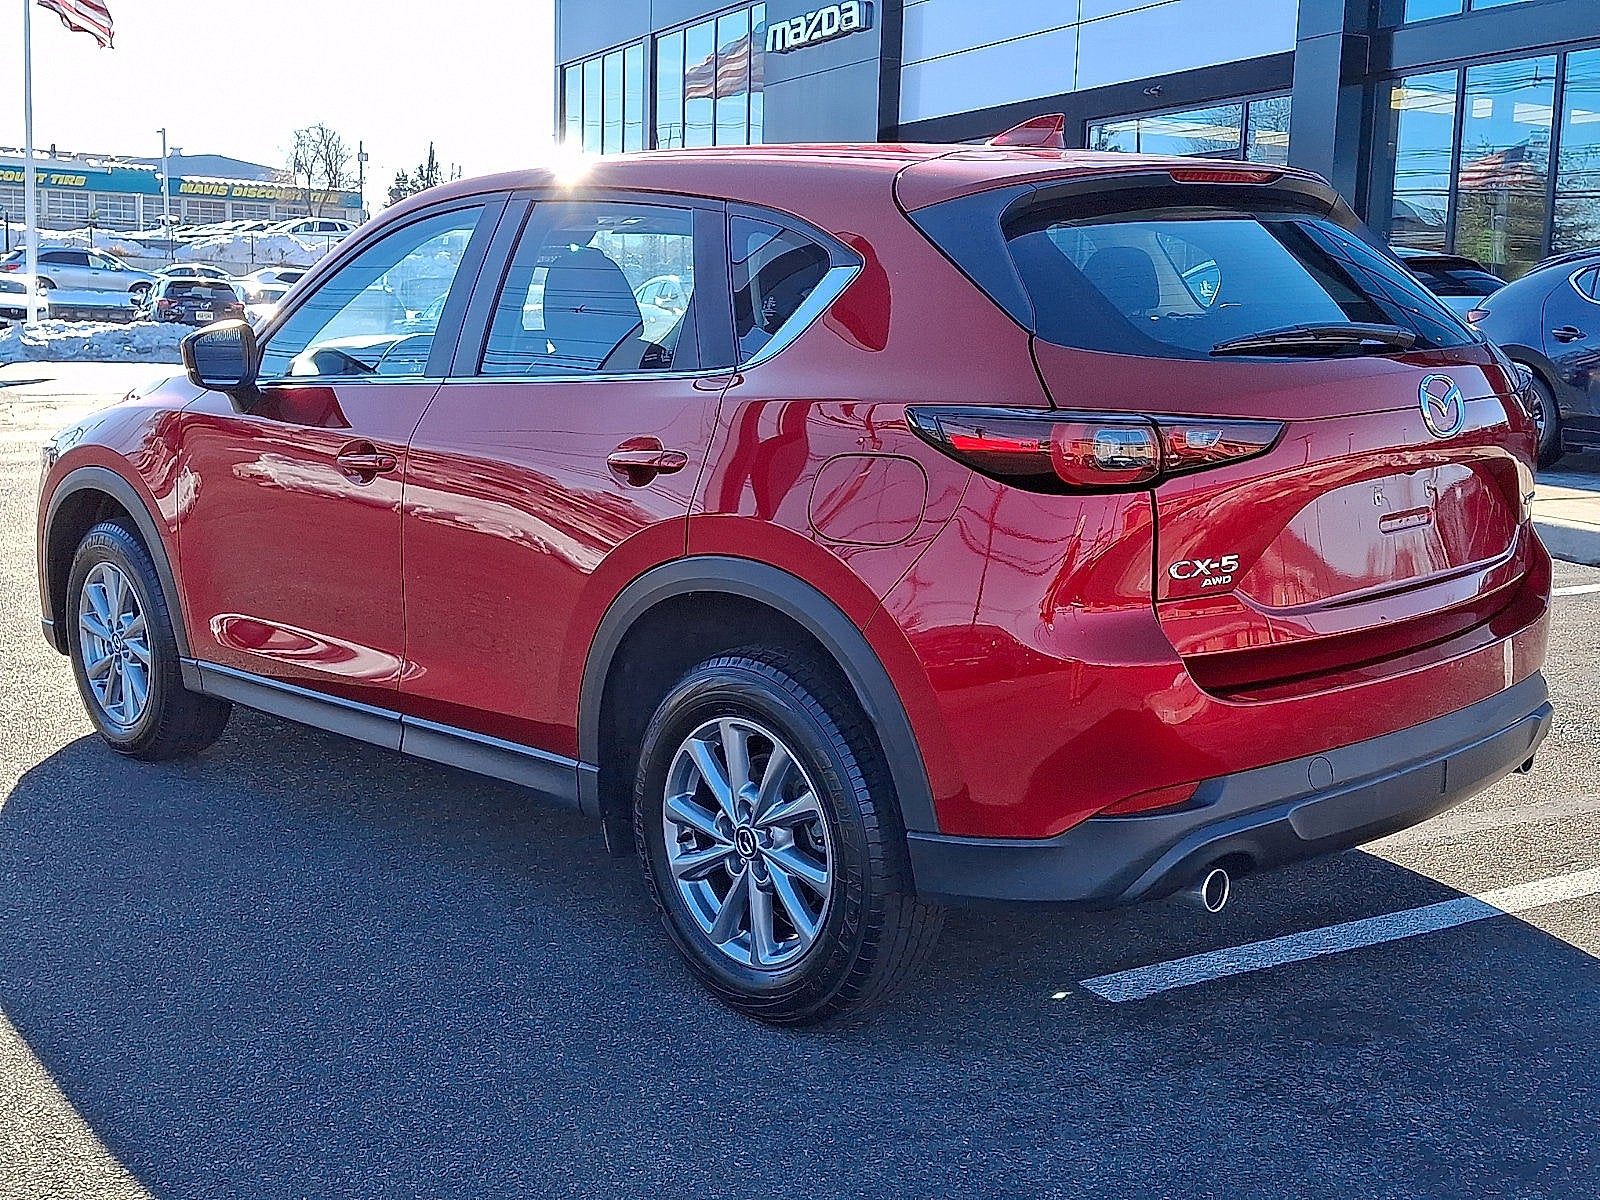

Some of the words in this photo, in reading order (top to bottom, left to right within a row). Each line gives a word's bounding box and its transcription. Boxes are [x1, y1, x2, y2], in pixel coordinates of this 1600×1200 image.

[766, 0, 860, 51] mazda
[50, 174, 86, 186] TIRE
[179, 183, 229, 196] MAVIS
[1169, 554, 1239, 580] CX-5
[1201, 575, 1232, 588] AWD
